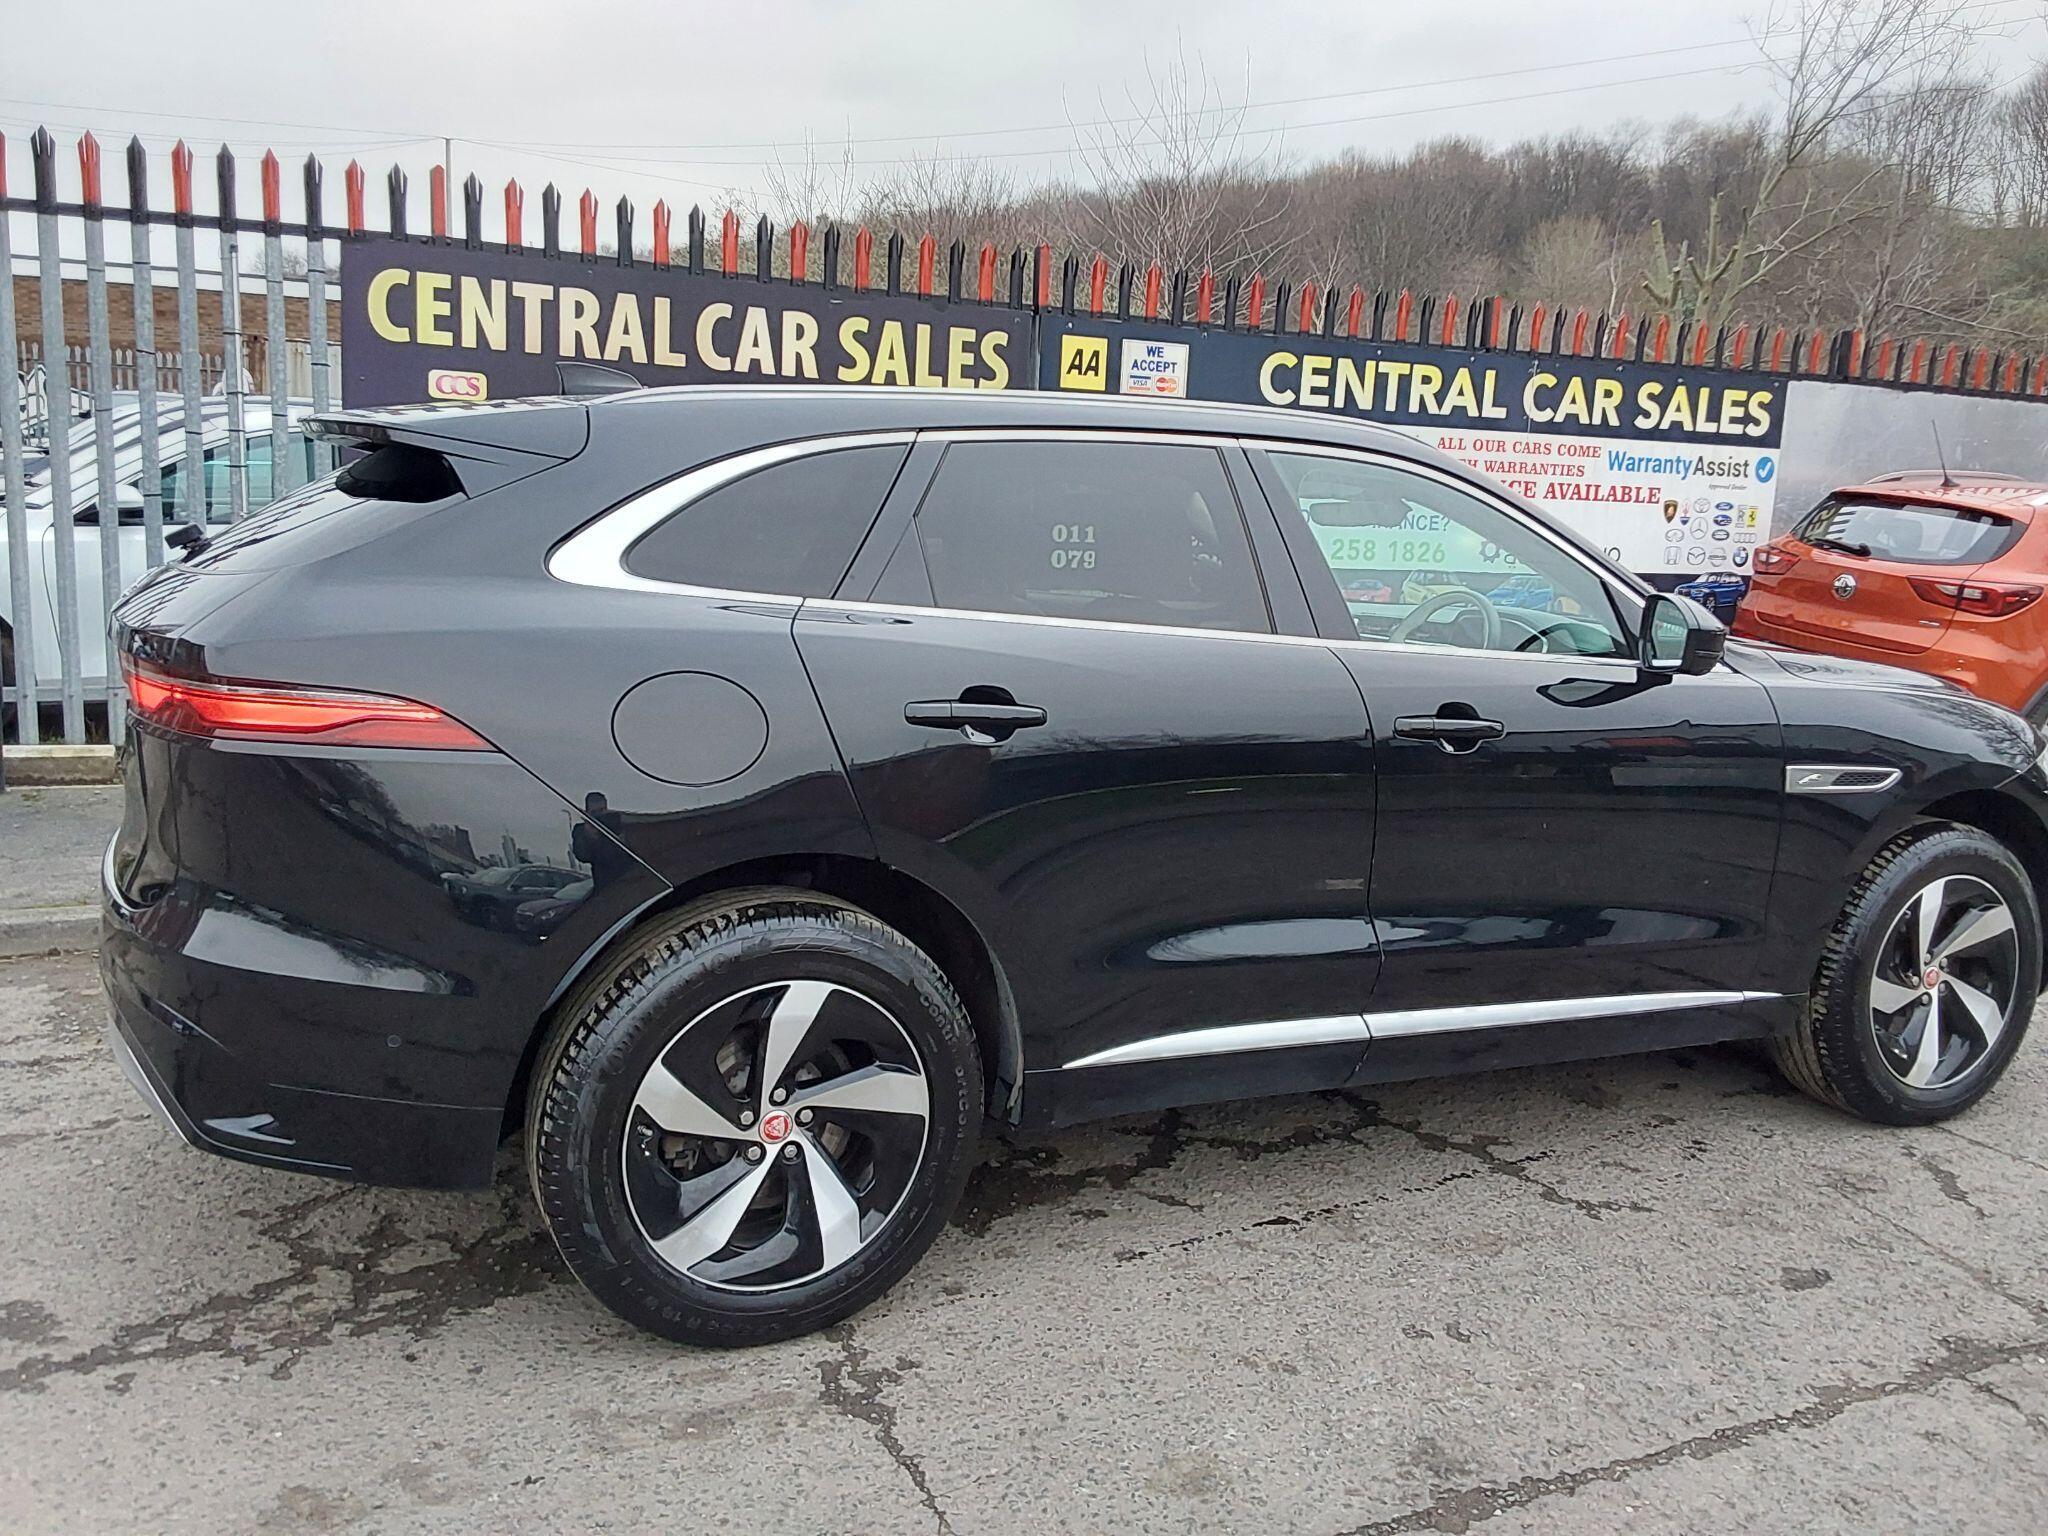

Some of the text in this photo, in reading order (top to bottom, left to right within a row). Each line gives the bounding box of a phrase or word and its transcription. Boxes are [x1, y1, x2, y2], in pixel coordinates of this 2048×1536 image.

[367, 268, 1009, 390] CENTRAL CAR SALES
[1066, 348, 1100, 377] AA
[1146, 346, 1164, 358] WE
[1131, 359, 1177, 374] ACCEPT
[435, 374, 481, 397] CCS
[1259, 351, 1773, 437] CENTRAL CAR SALES
[1437, 437, 1602, 458] ALL OUR CARS COME
[1484, 460, 1585, 478] WARRANTIES
[1542, 482, 1661, 504] AVAILABLE
[1052, 524, 1096, 543] 011
[1050, 550, 1096, 569] 079
[1330, 538, 1446, 564] 258 1826
